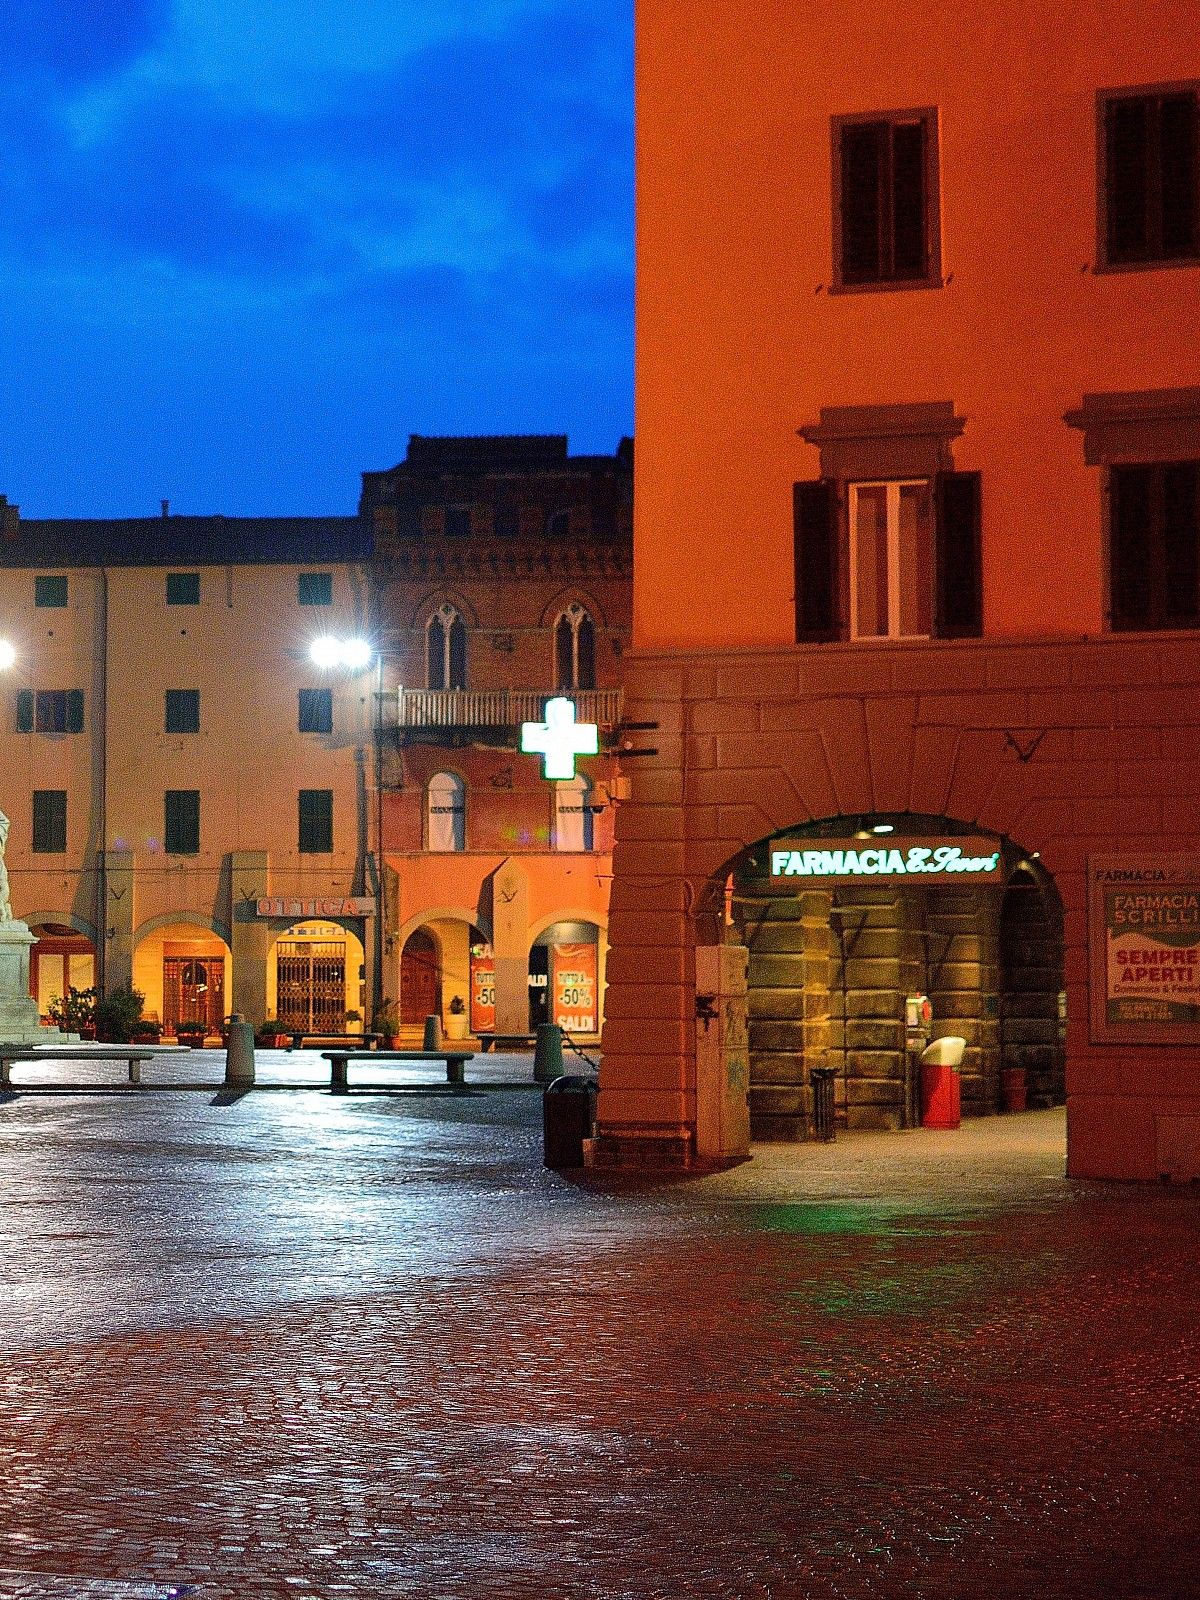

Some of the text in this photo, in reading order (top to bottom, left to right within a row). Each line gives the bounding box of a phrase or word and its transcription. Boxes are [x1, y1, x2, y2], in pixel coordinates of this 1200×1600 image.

[772, 849, 906, 875] FARMACIA
[1096, 869, 1166, 881] FARMACIA
[259, 898, 358, 917] OTTICA
[1114, 895, 1199, 909] FARMACIA
[1114, 910, 1199, 924] SCRILLI
[1116, 949, 1199, 965] SEMPRE
[527, 974, 548, 987] ALDI
[1121, 967, 1193, 982] APERTI
